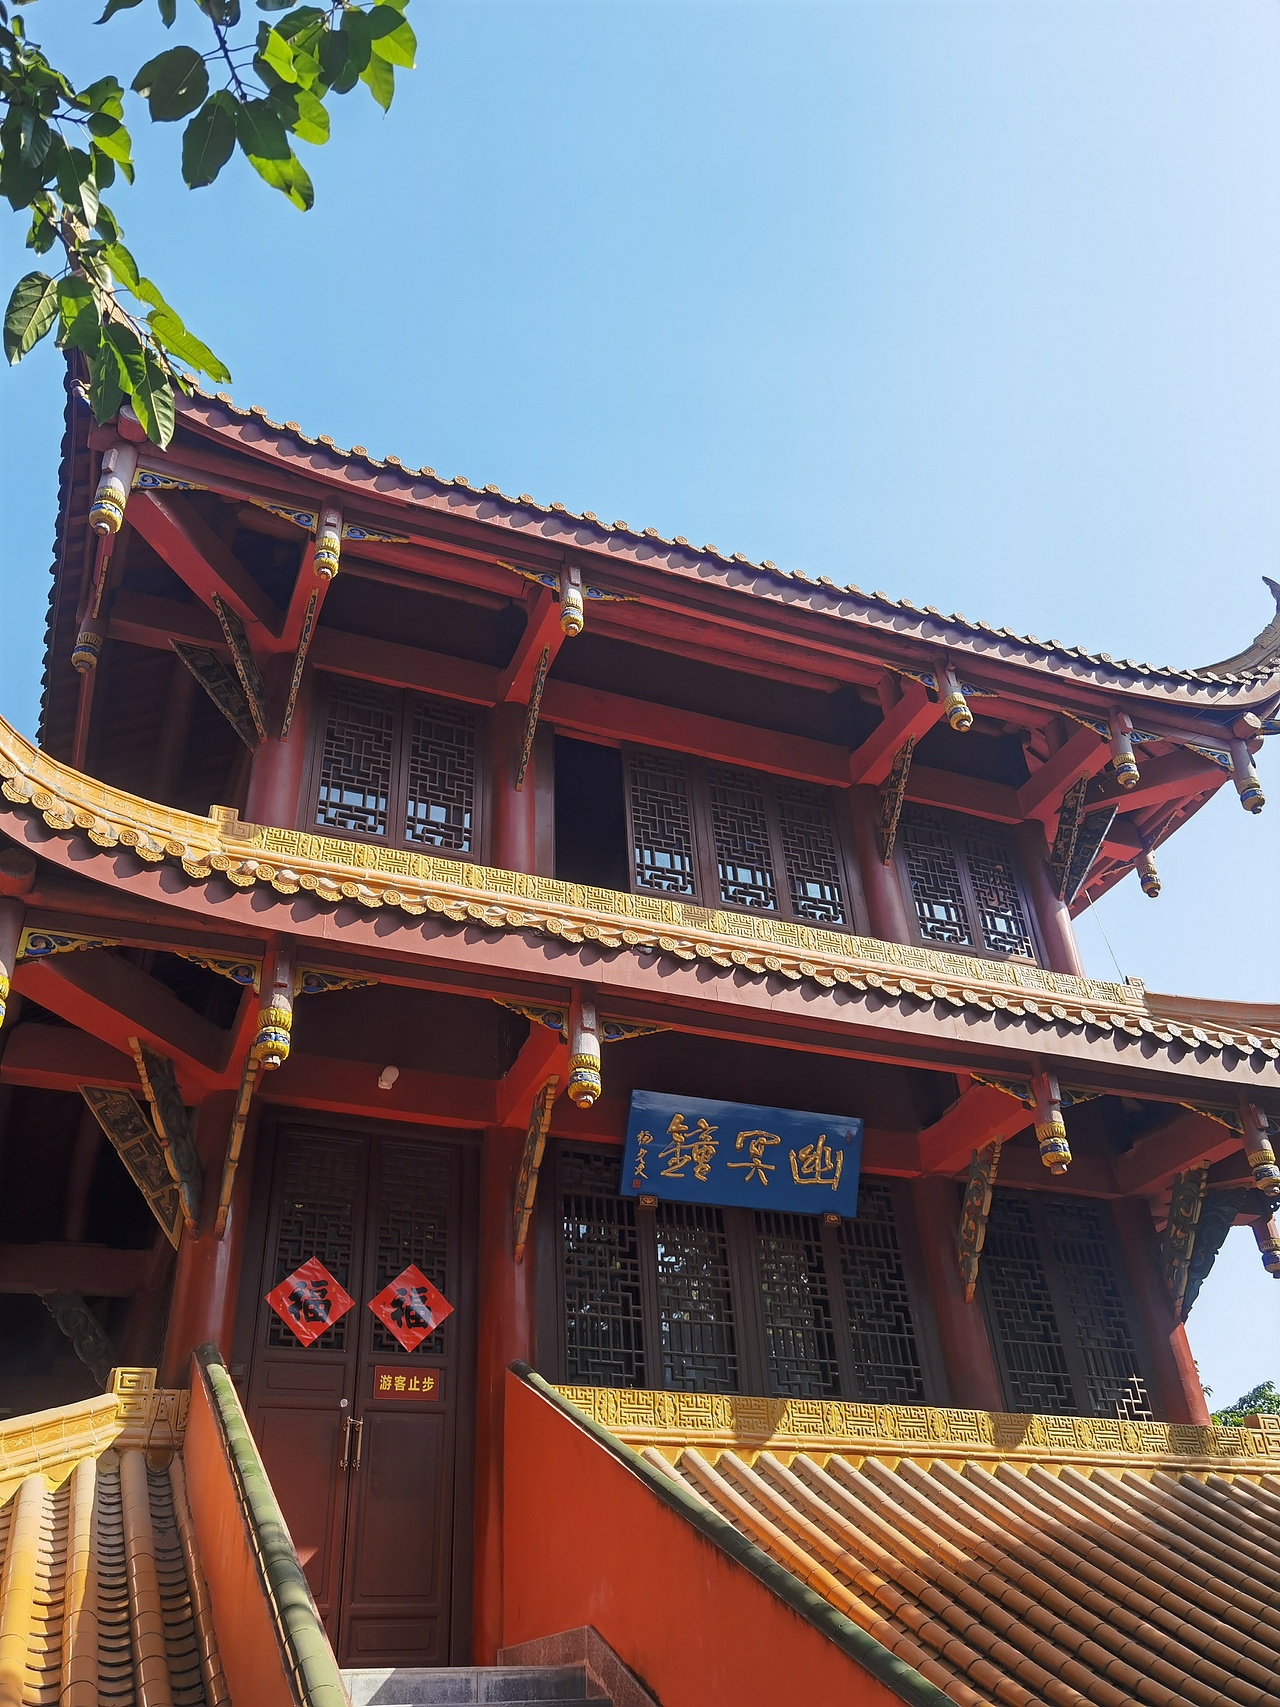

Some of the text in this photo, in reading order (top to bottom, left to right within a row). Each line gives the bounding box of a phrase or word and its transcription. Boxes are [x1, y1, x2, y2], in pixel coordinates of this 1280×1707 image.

[287, 1279, 332, 1323] 福
[390, 1286, 432, 1330] 福
[379, 1374, 435, 1392] 游客止步
